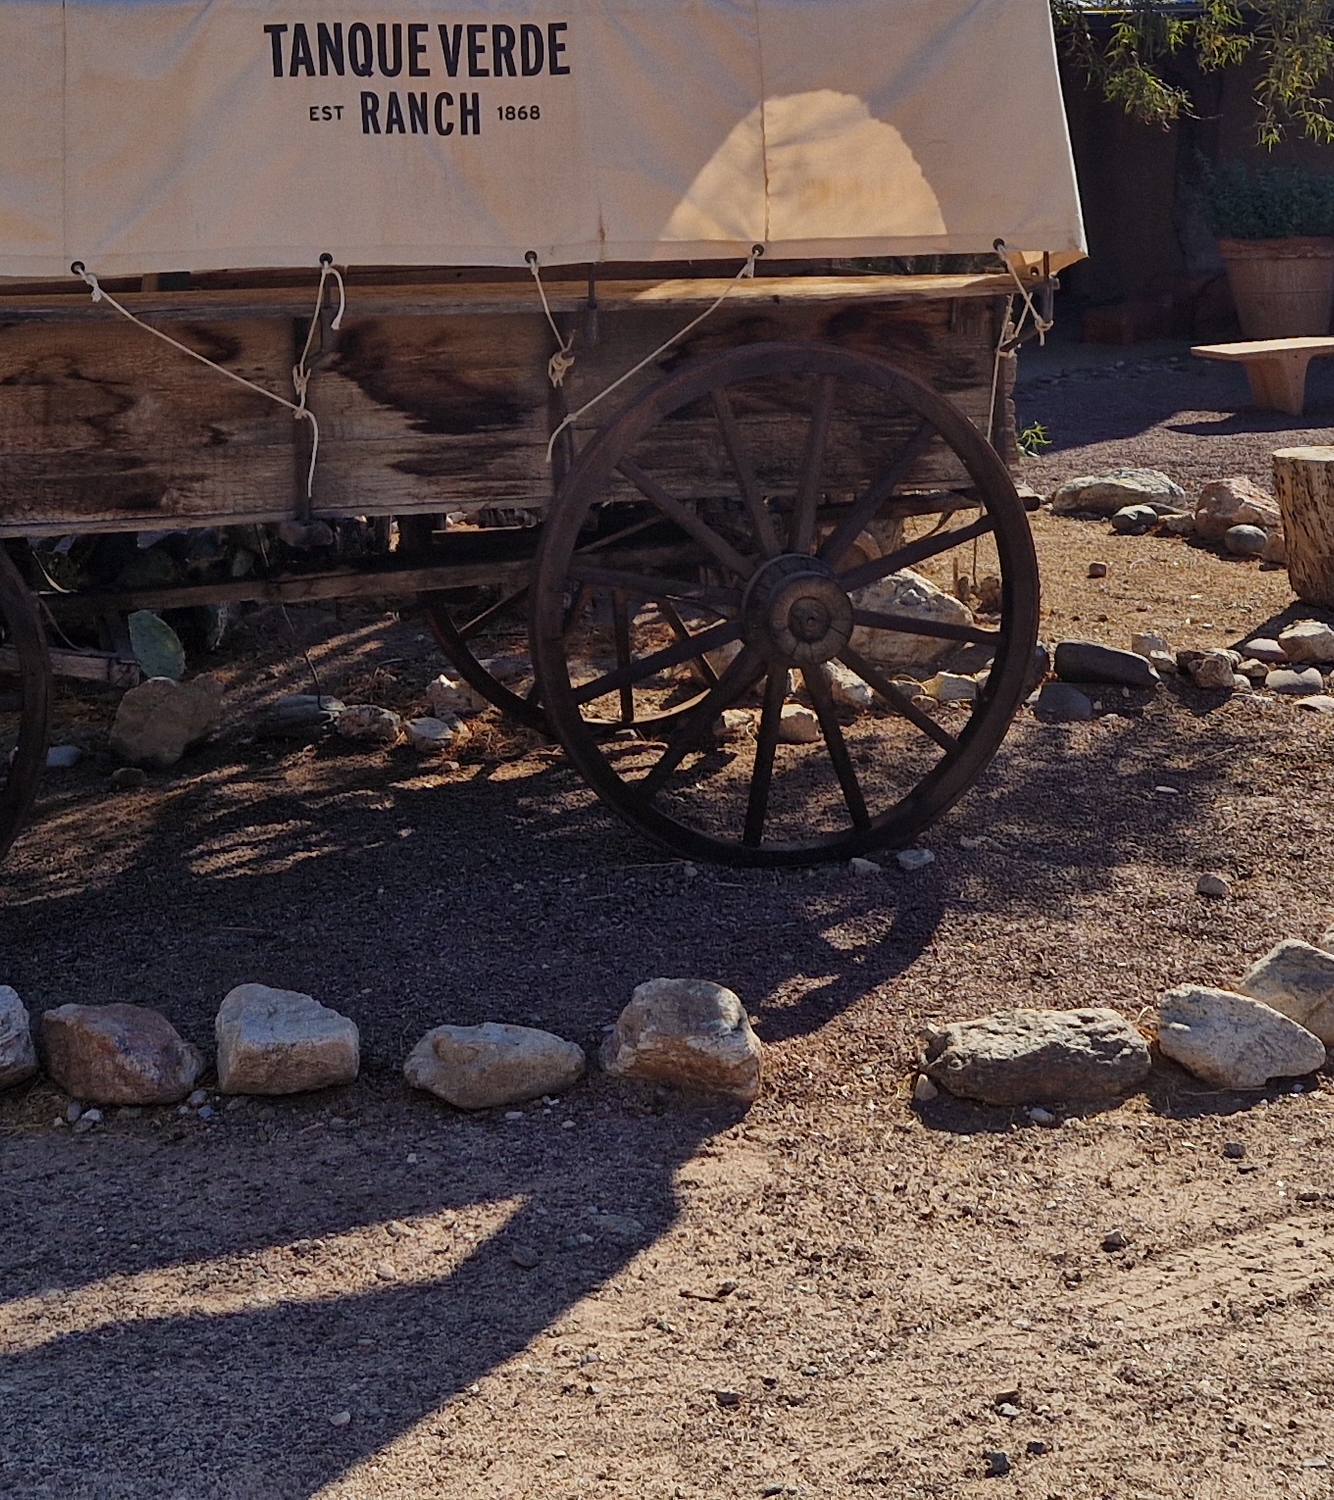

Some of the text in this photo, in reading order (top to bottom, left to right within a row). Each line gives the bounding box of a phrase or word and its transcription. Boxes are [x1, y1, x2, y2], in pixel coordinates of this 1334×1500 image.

[264, 22, 570, 77] TANQUE VERDE
[310, 91, 540, 136] EST RANCH 1868
